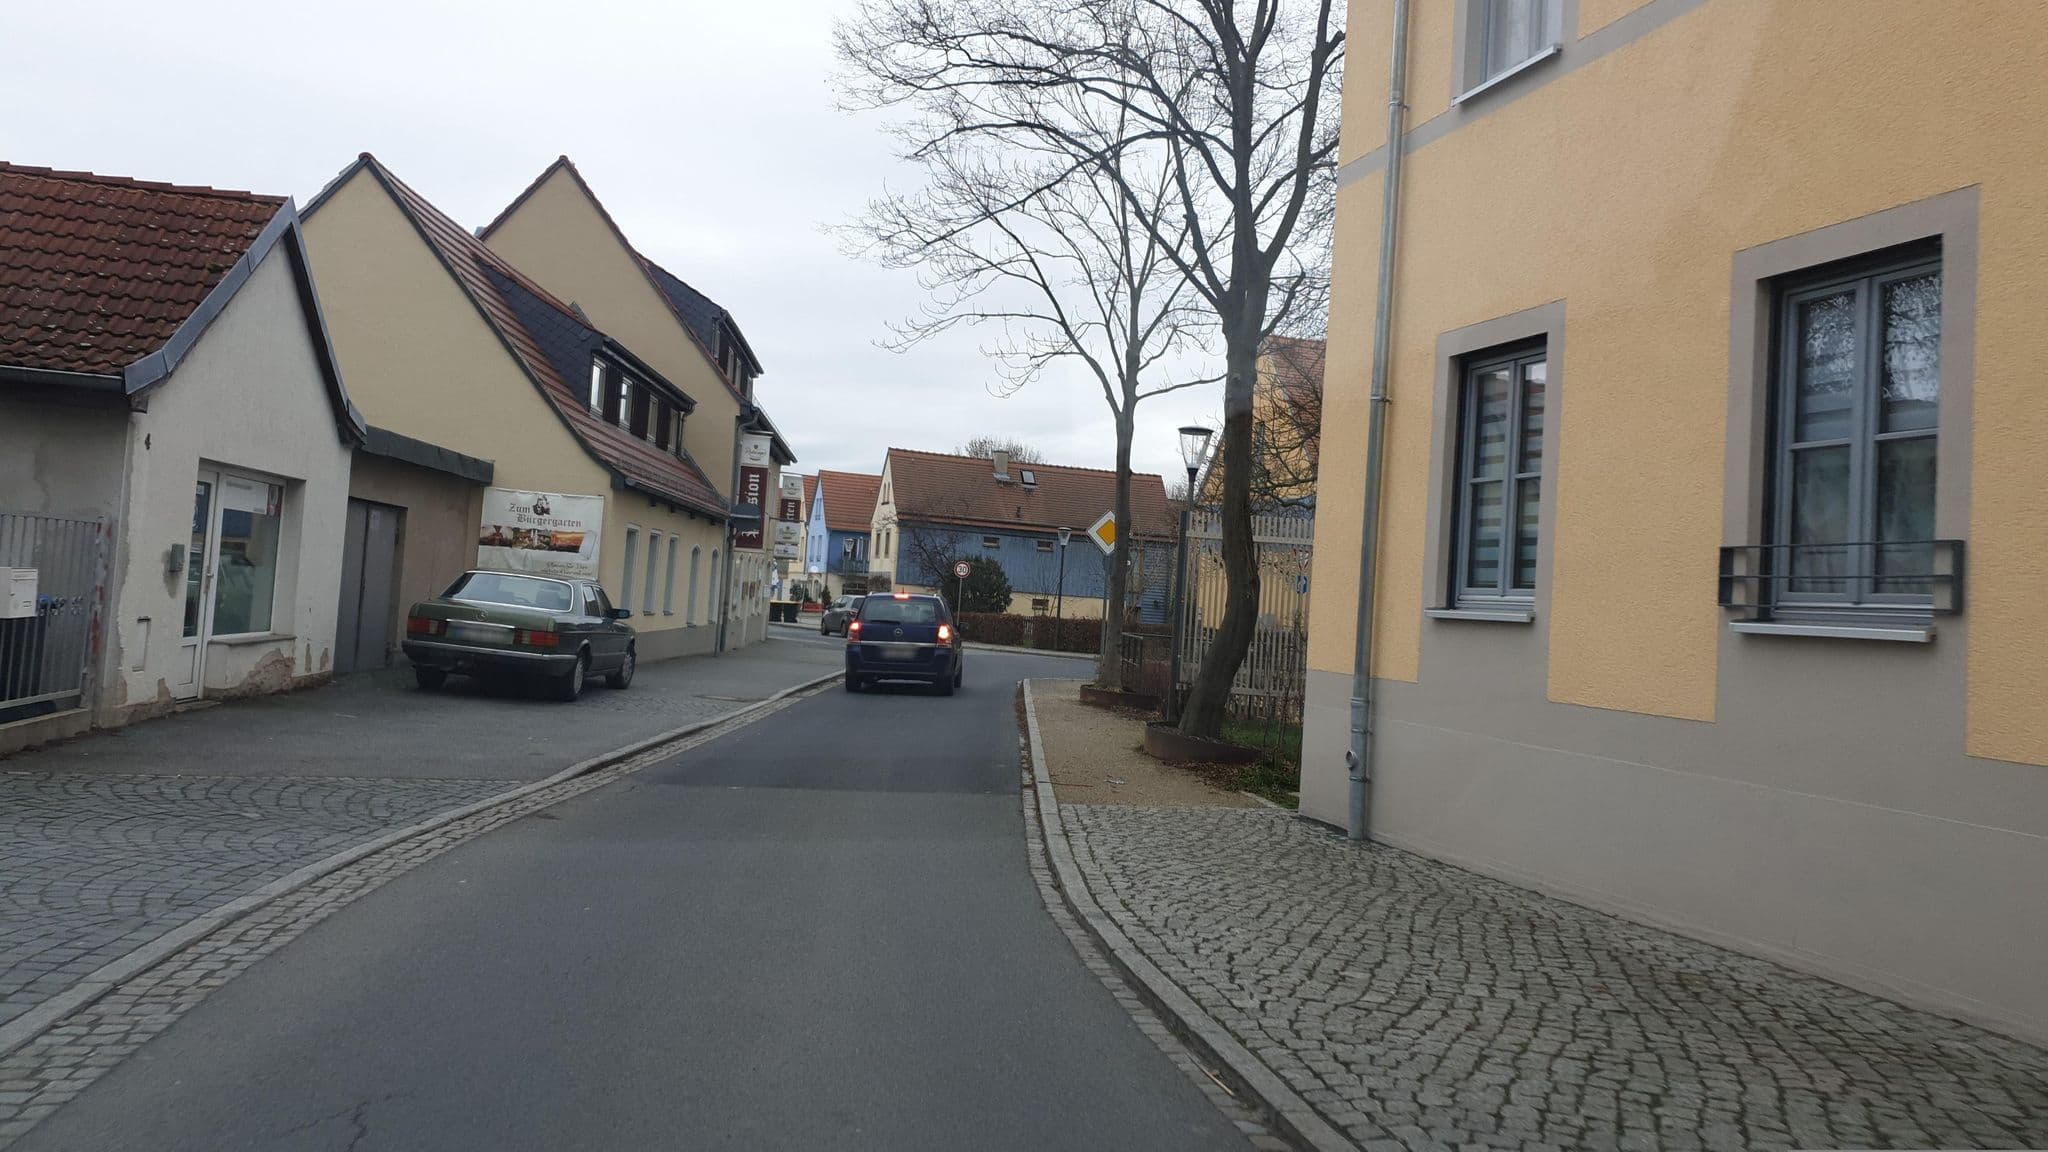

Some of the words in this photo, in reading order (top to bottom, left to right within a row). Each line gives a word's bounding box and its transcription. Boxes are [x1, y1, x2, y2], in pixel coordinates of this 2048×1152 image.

[509, 502, 531, 513] Zum
[741, 474, 760, 538] Psion
[516, 513, 582, 528] Bürgergarten
[958, 565, 967, 573] 30
